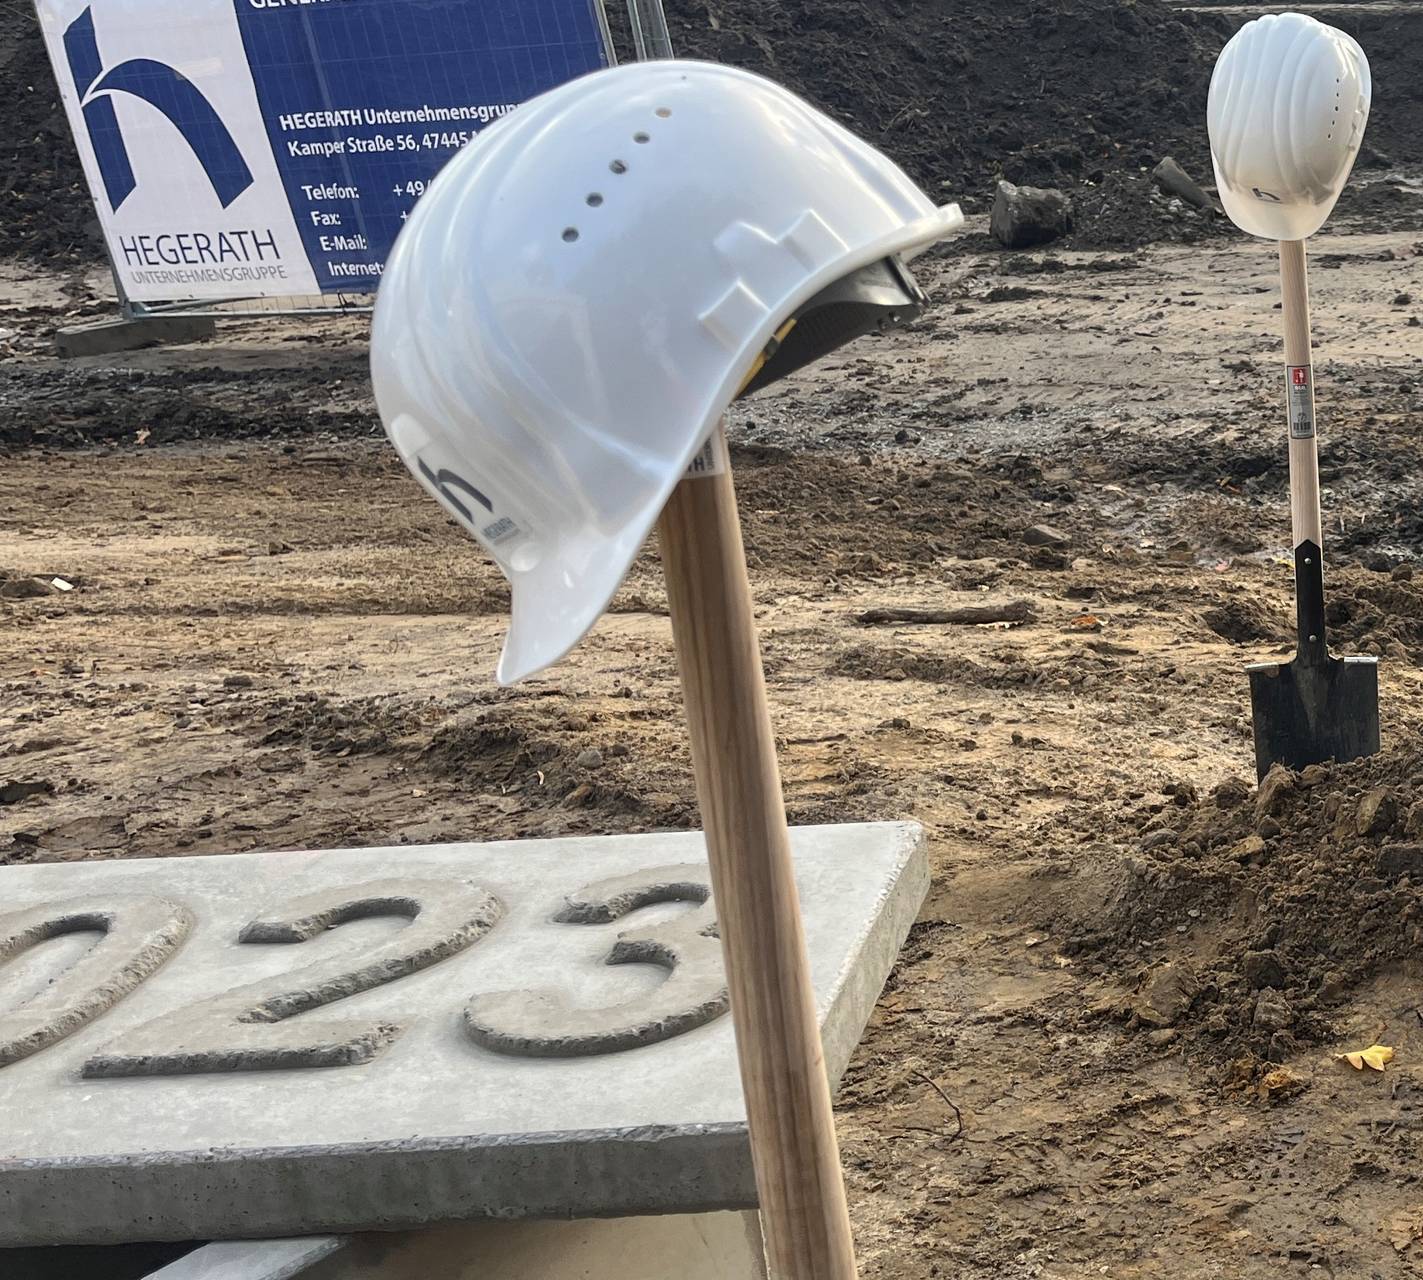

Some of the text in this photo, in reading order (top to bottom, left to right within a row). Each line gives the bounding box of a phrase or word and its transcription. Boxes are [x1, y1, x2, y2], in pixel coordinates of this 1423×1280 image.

[279, 104, 520, 131] HEGERATH Unternehmensgru
[287, 140, 345, 158] Kamper
[347, 134, 394, 153] Straße
[396, 134, 420, 152] 56,
[422, 131, 469, 149] 47445
[301, 182, 360, 201] Telefon:
[310, 210, 341, 226] Fax:
[119, 229, 281, 266] HEGERATH
[319, 233, 367, 251] E-Mail:
[131, 265, 288, 285] UNTERNEHMENSGRUPPE
[328, 261, 384, 276] Internet:
